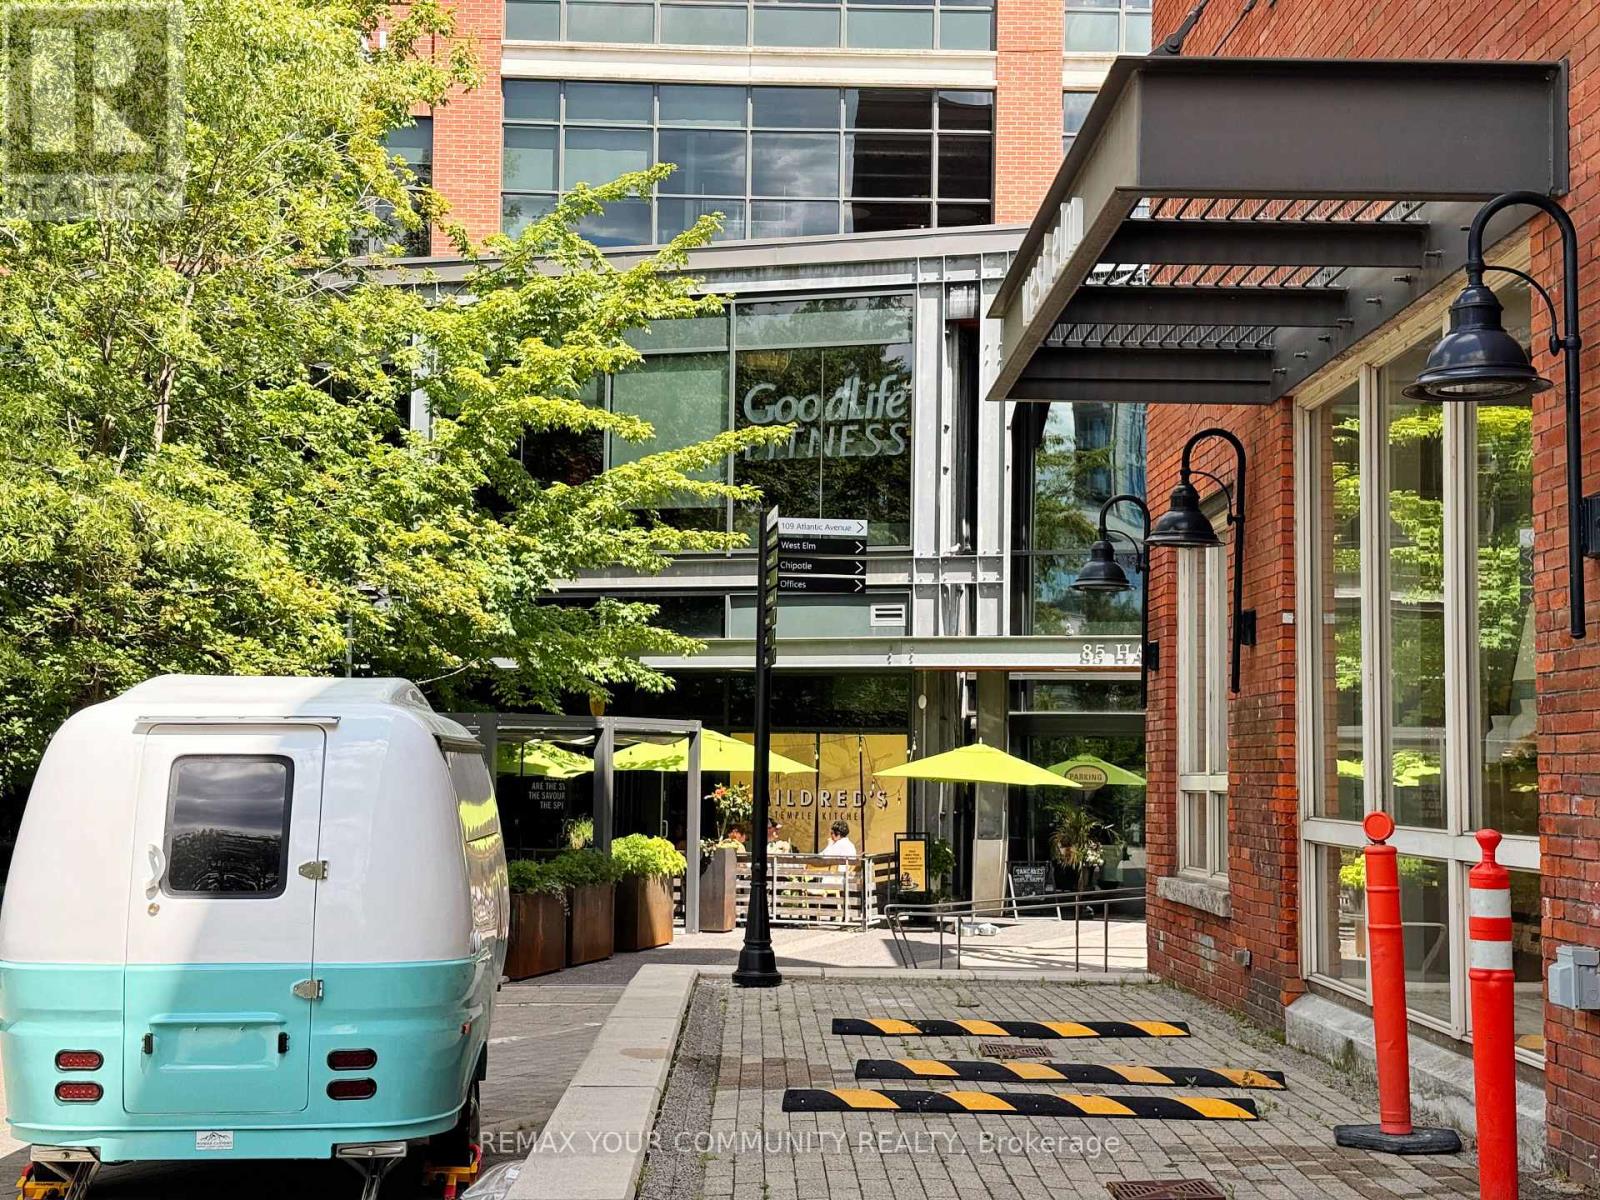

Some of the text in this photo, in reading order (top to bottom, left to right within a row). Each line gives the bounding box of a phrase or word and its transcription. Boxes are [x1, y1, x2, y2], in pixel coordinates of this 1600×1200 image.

[743, 374, 907, 424] GoodLife
[782, 522, 852, 532] 109 Atlantic Avenue
[780, 541, 817, 551] West Elm
[780, 561, 813, 570] Chipotle
[780, 580, 807, 589] Offices
[1081, 643, 1106, 661] 85
[1069, 771, 1103, 781] PARKING
[531, 781, 544, 791] ARE
[545, 781, 558, 791] THE
[528, 791, 540, 800] THE
[768, 788, 888, 809] ILDRED'S
[540, 801, 552, 809] THE
[775, 811, 864, 821] TEMPLE KITCHE
